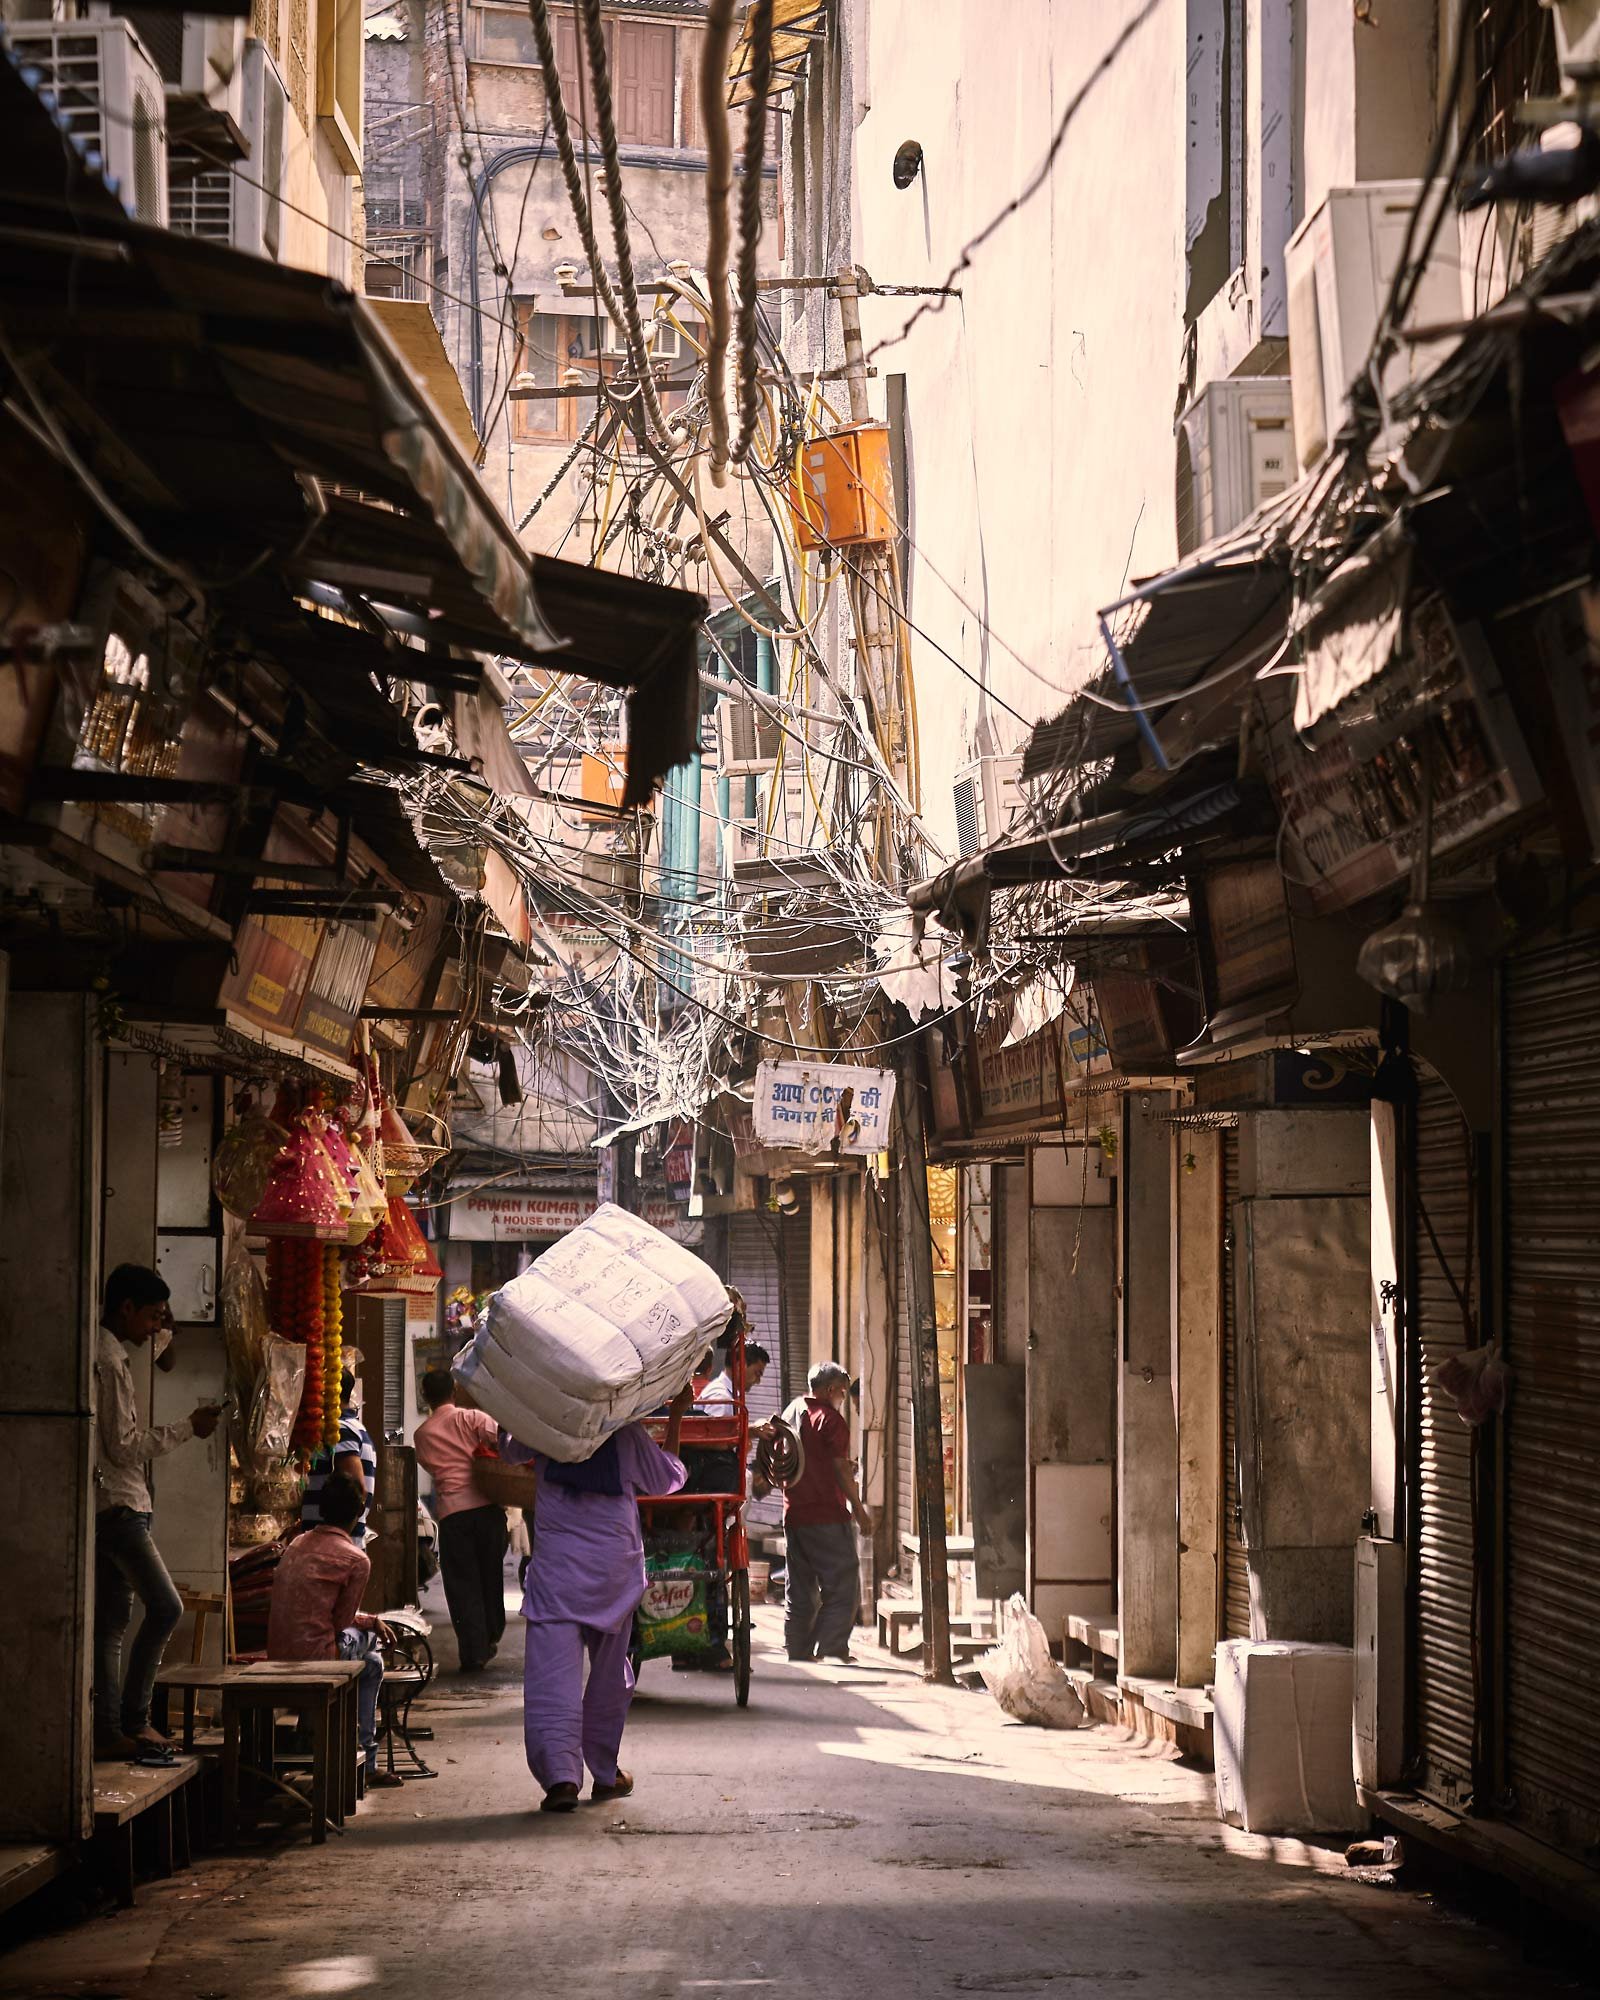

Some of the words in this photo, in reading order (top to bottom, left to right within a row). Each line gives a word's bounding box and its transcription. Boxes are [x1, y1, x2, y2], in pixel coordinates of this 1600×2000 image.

[810, 1086, 844, 1103] CCT
[860, 1087, 881, 1108] की
[467, 1198, 521, 1212] PAWAN
[527, 1200, 579, 1214] KUMAR
[491, 1215, 500, 1225] A
[503, 1215, 543, 1226] HOUSE
[546, 1217, 561, 1226] OF
